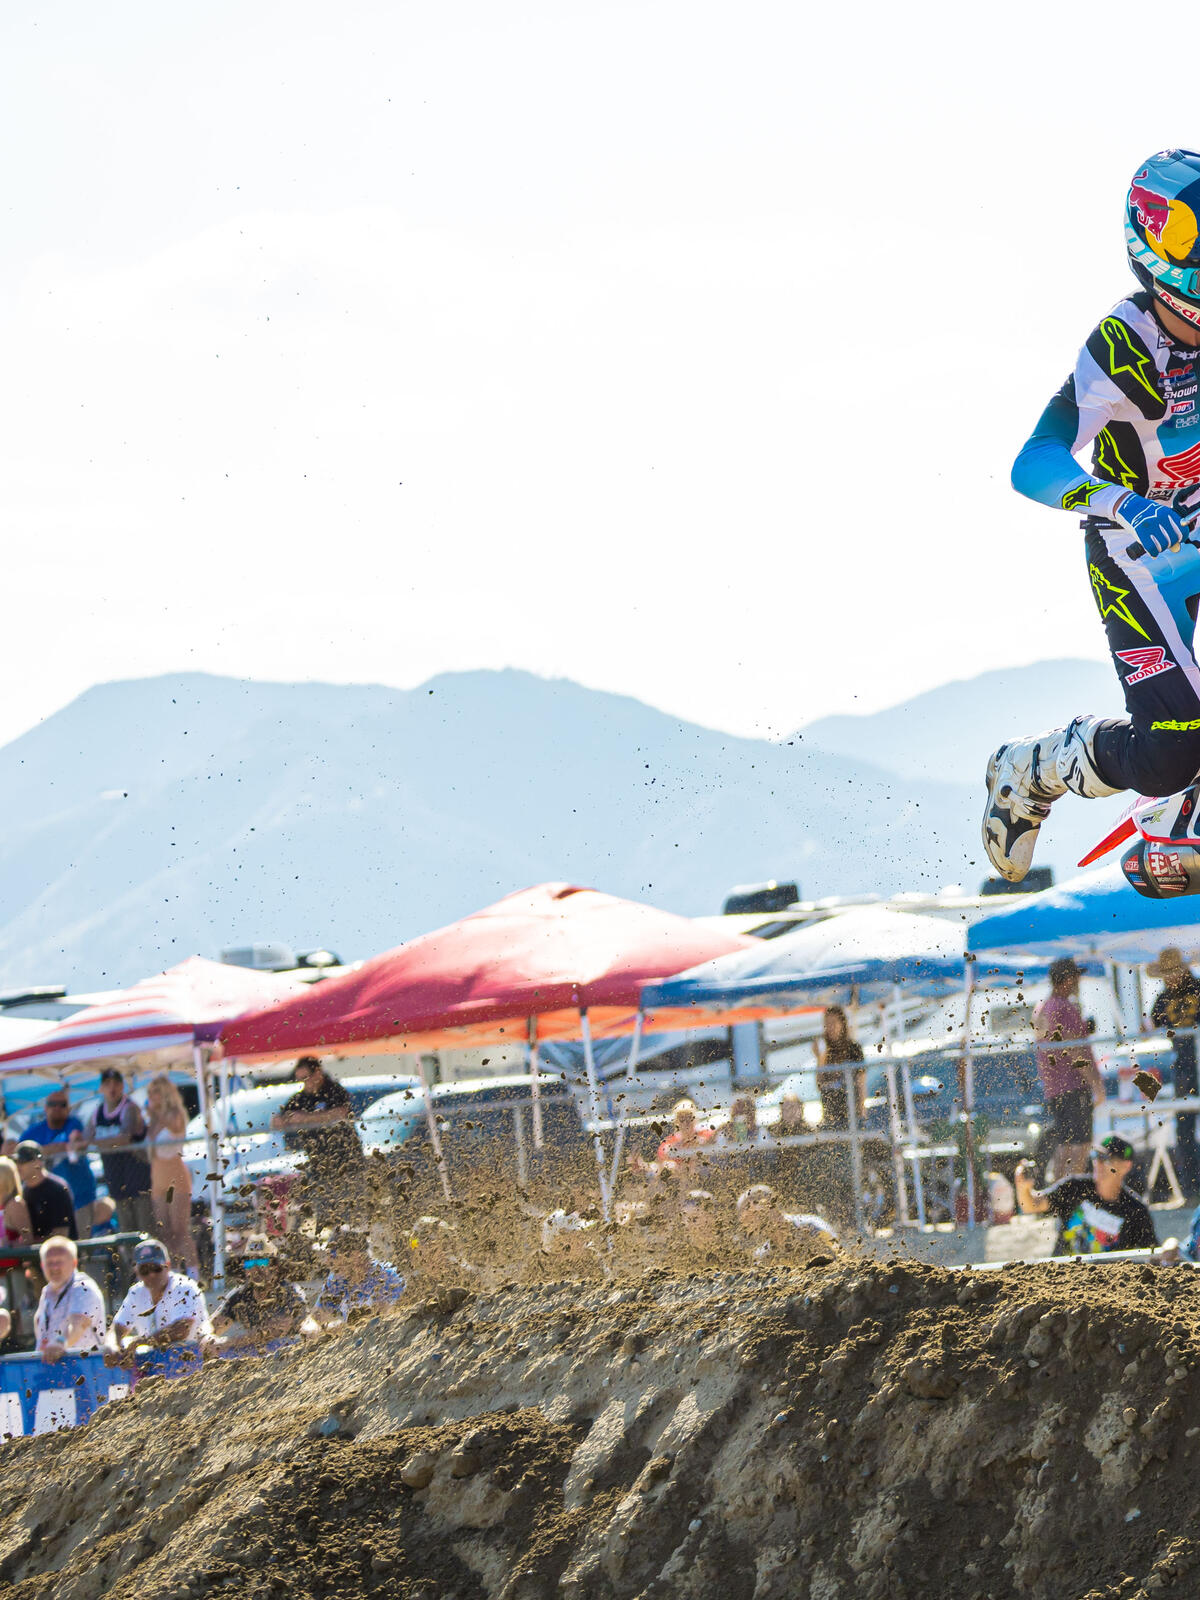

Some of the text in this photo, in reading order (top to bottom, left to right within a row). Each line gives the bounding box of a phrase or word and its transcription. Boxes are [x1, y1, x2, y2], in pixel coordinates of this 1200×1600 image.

[1160, 291, 1198, 320] Red
[1163, 385, 1198, 399] SHOWA
[1172, 404, 1192, 413] 100%
[1176, 420, 1199, 429] LOCK
[1127, 660, 1174, 684] HONDA
